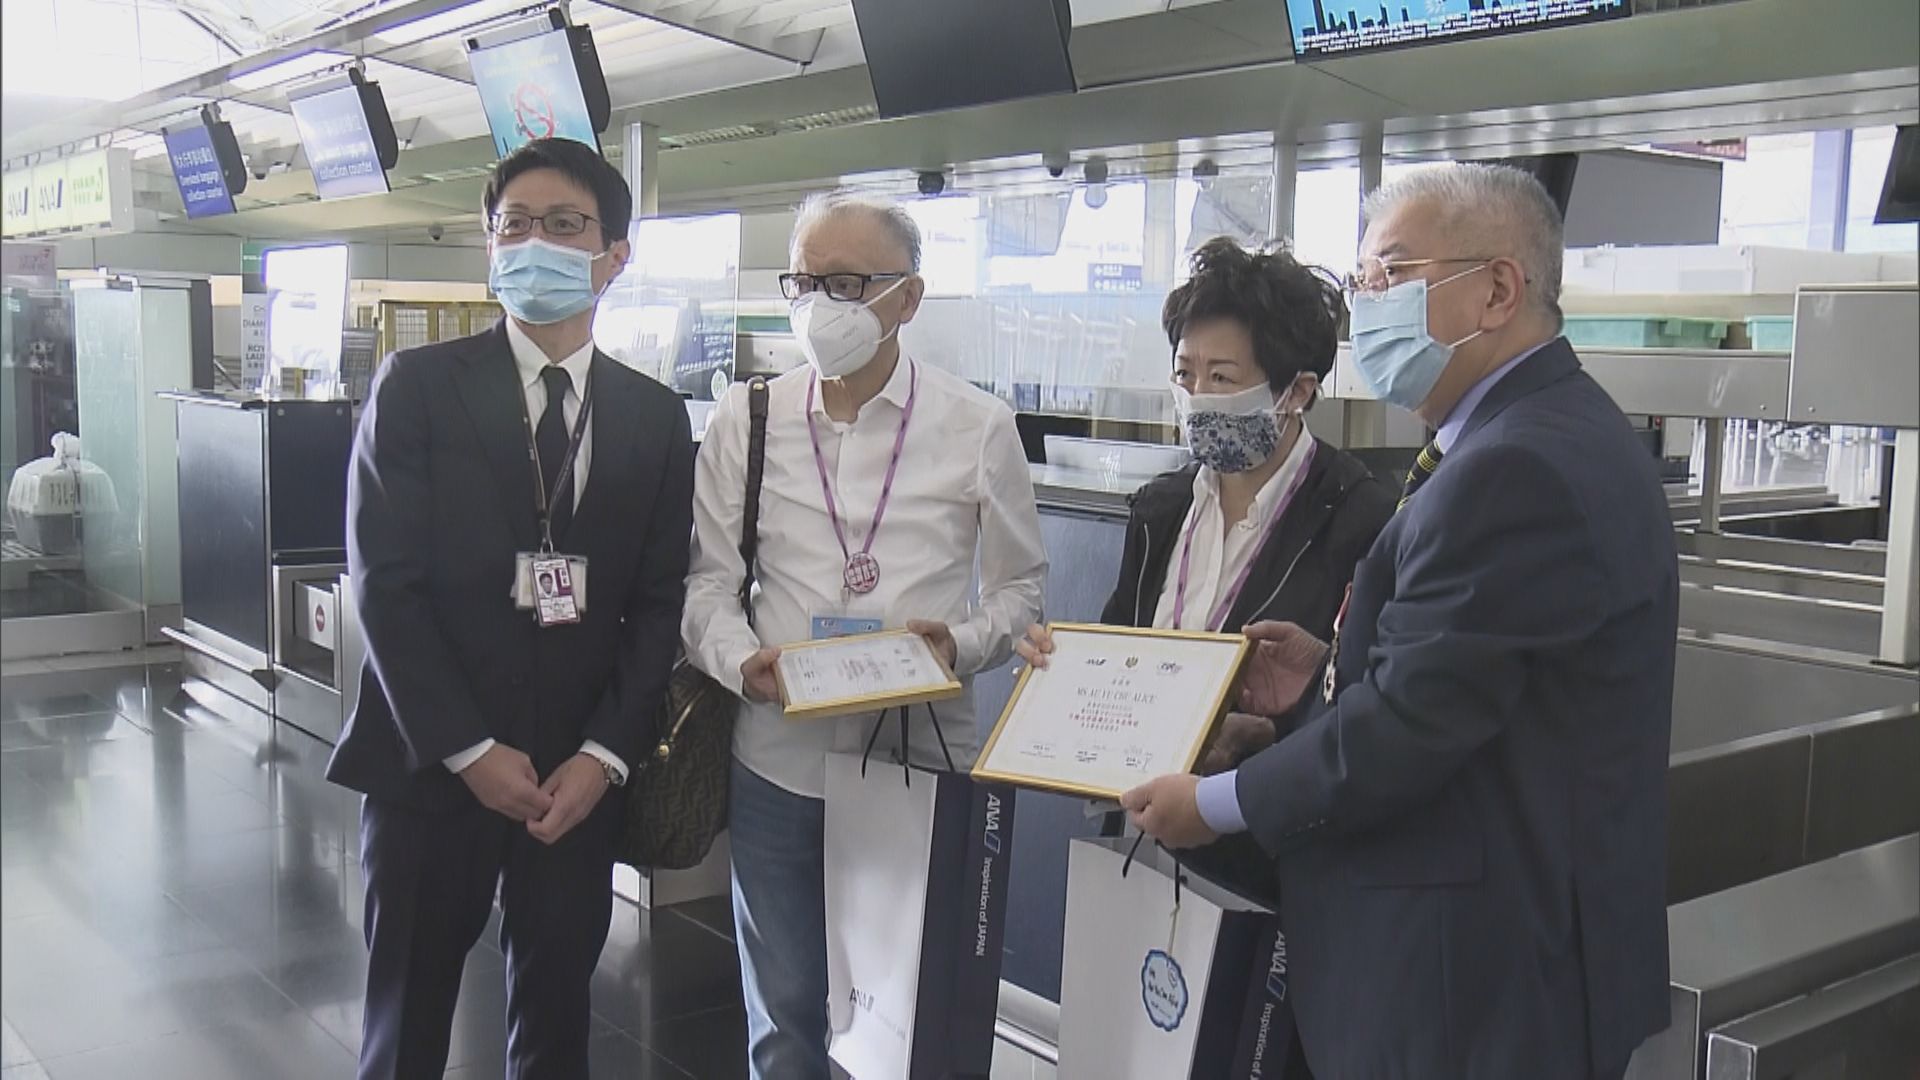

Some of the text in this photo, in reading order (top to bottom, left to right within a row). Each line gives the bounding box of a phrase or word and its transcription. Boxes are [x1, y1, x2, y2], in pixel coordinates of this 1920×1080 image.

[975, 793, 1001, 957] ANA Inspiration of JAPAN
[1269, 930, 1287, 974] ANA
[1254, 1002, 1275, 1060] Inspiration
[1251, 1060, 1262, 1076] of
